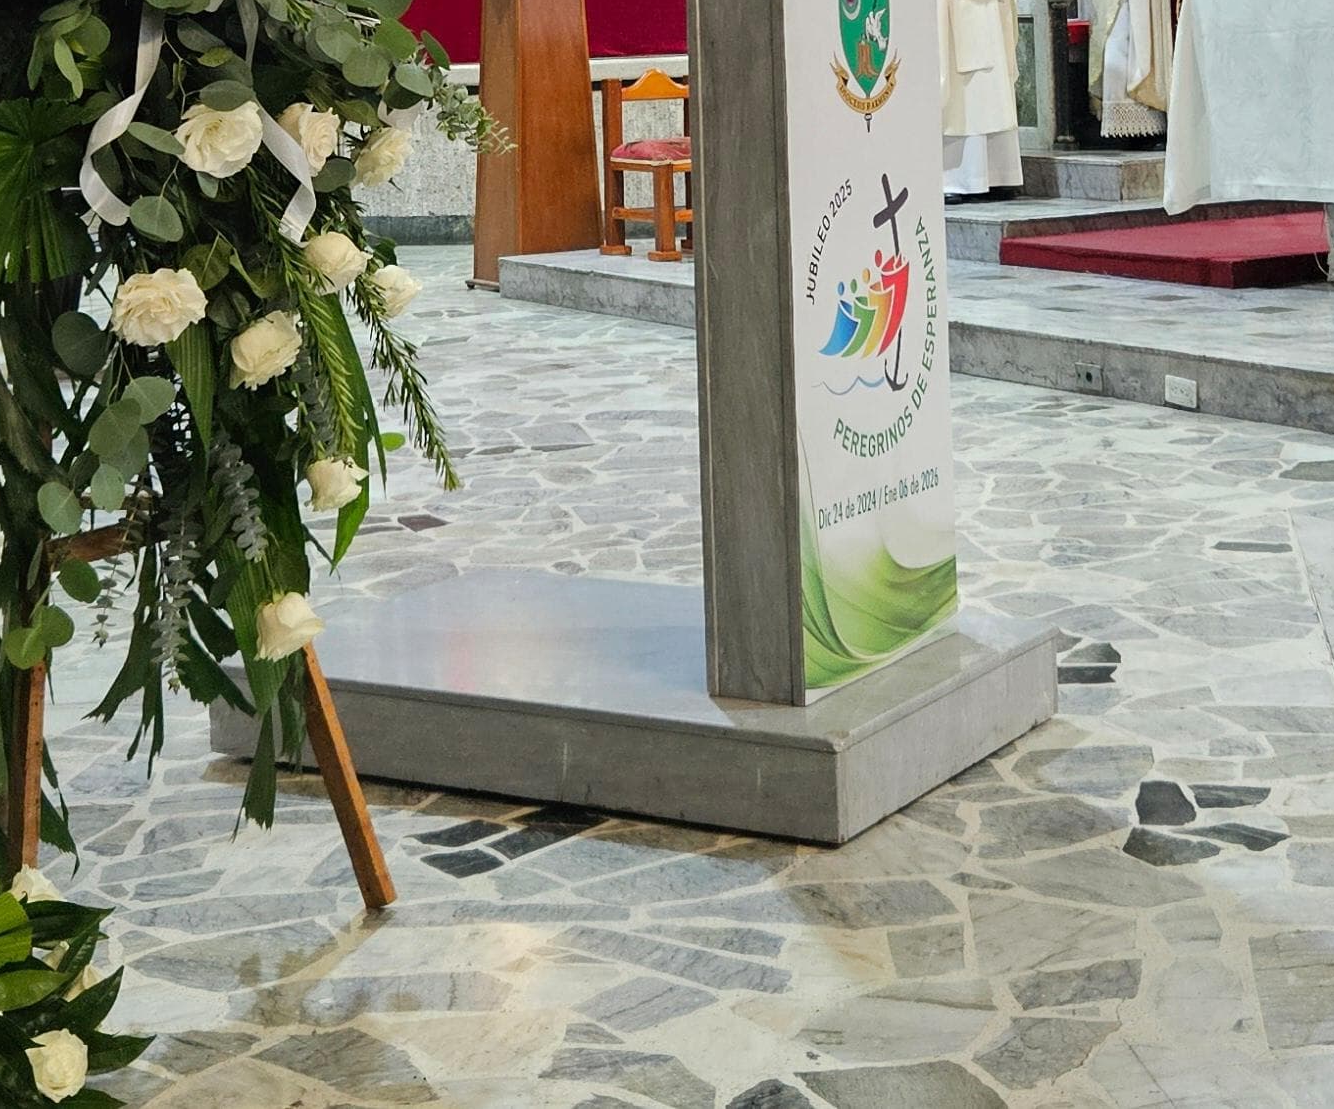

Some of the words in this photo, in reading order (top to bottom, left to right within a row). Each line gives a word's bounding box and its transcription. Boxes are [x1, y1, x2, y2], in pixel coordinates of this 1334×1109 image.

[805, 215, 831, 305] JUBILEO
[829, 178, 853, 218] 2025
[915, 215, 938, 372] ESPERANZA
[910, 372, 928, 411] DE
[833, 405, 914, 459] PEREGRINOS
[818, 508, 831, 530] Dic
[832, 501, 843, 524] 24
[845, 497, 855, 519] de
[857, 489, 876, 515] 2024
[884, 485, 897, 505] Ene
[910, 474, 920, 495] de
